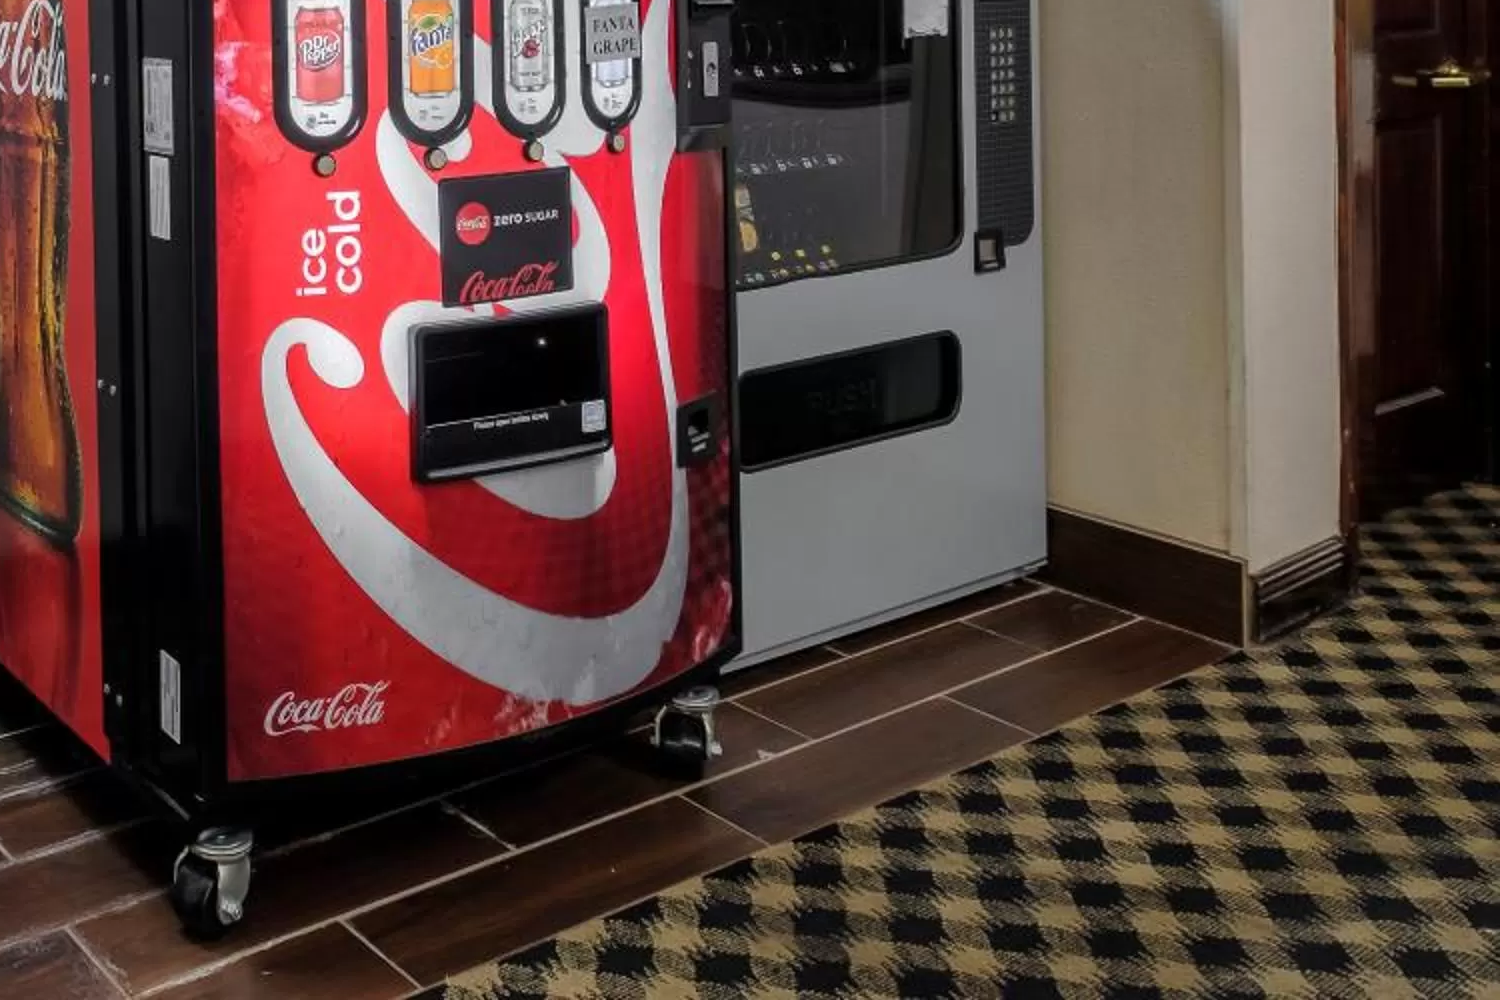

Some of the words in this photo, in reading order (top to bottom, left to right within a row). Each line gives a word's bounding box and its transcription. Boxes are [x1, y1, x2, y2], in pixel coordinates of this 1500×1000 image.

[593, 15, 635, 33] FANTA
[593, 37, 638, 55] GRAPE
[524, 208, 559, 223] SUGAR
[296, 228, 328, 297] ice
[326, 190, 363, 295] cold
[459, 260, 559, 305] Coca-Cola
[263, 679, 392, 737] Coca-Cola
